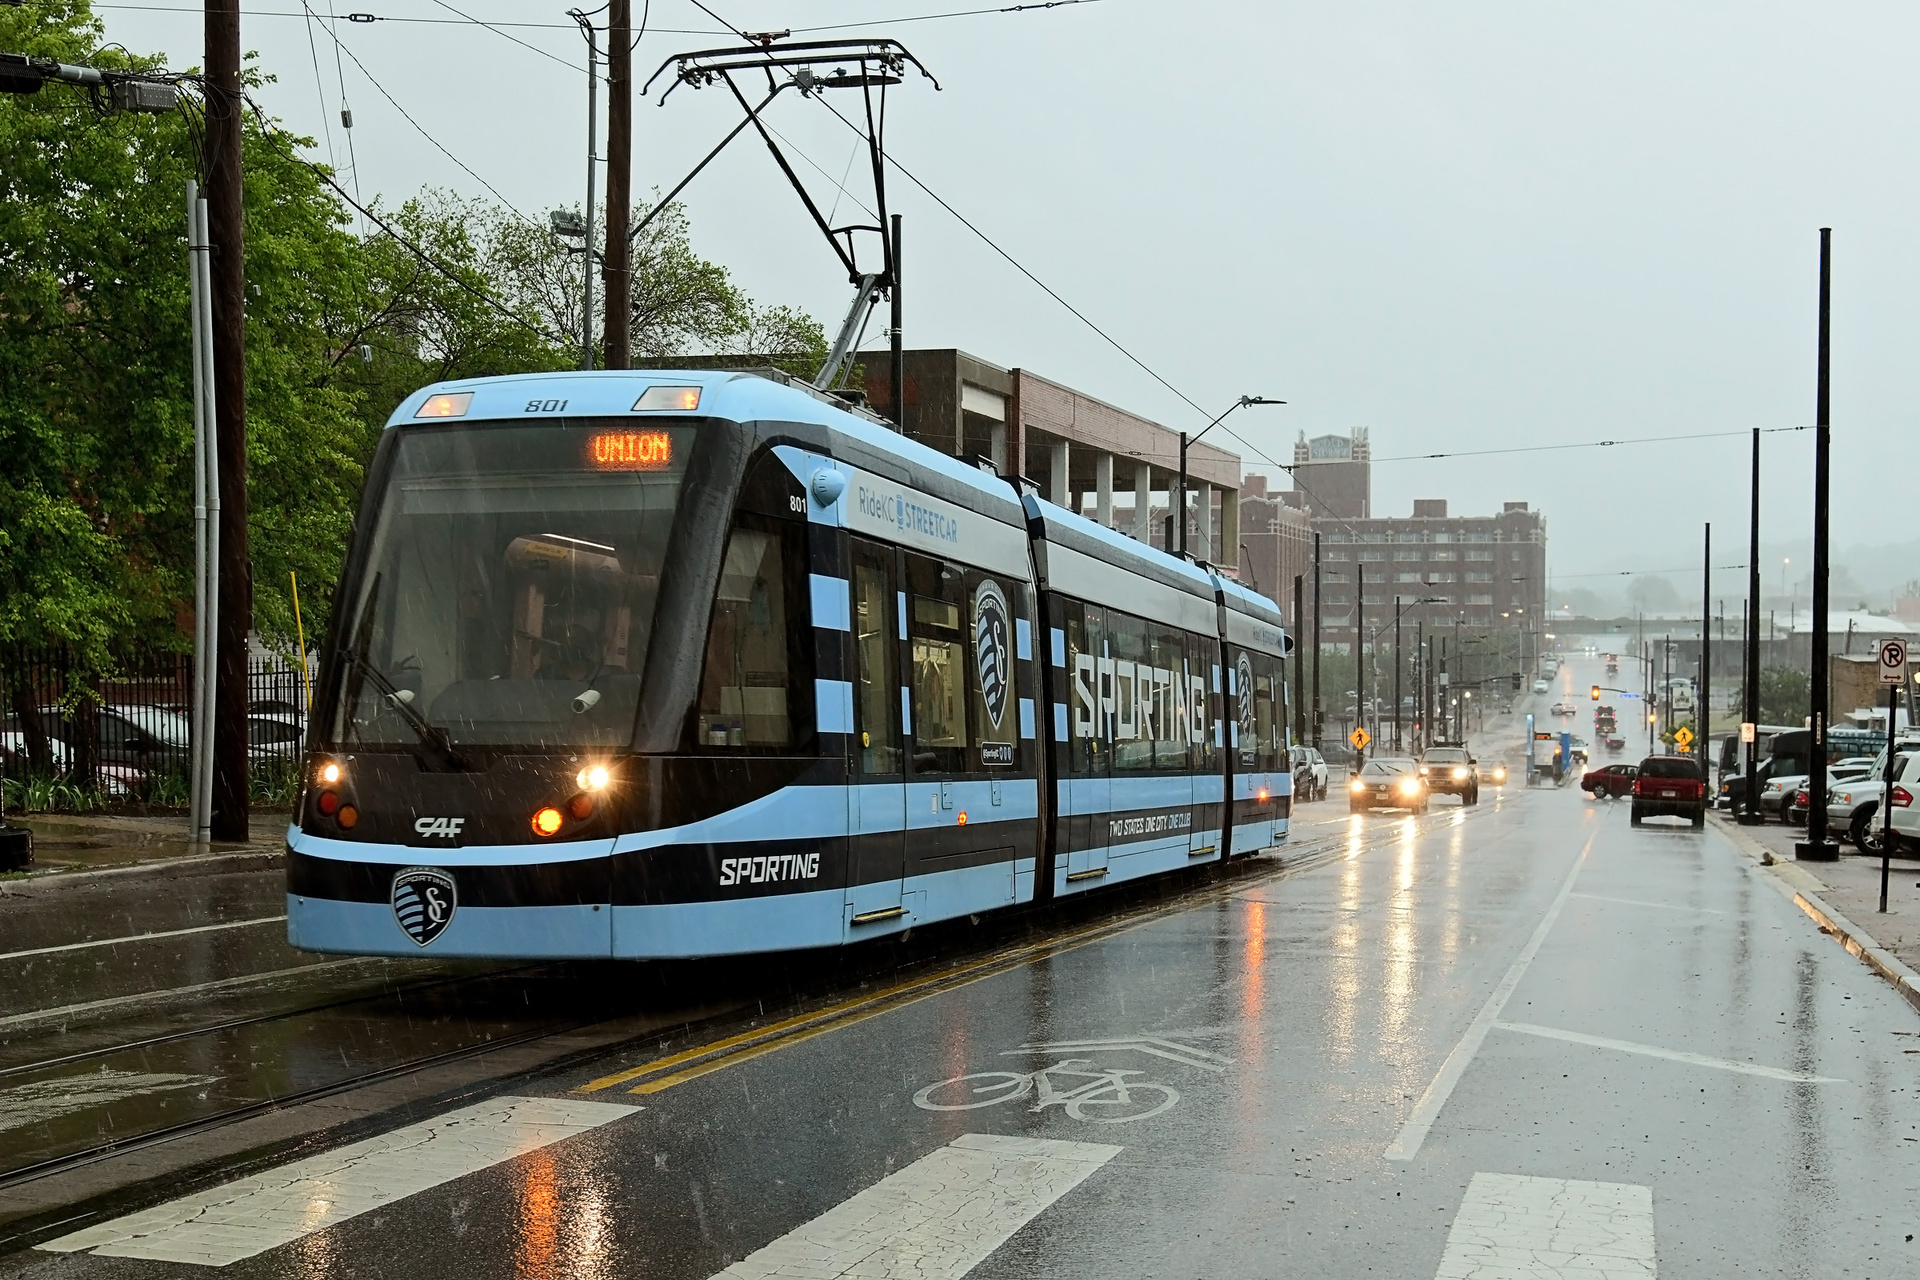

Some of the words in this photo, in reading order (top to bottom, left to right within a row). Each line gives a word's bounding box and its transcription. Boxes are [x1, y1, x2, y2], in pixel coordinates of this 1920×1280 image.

[525, 399, 569, 413] 801
[595, 433, 669, 462] UNION
[790, 495, 807, 514] 801
[859, 486, 895, 523] RideKC
[905, 502, 958, 543] STREETCAR
[1075, 653, 1205, 747] SPORTING
[414, 817, 465, 838] CAF
[1109, 820, 1123, 838] TWO
[1145, 816, 1156, 833] ONE
[1168, 813, 1179, 830] ONE
[720, 853, 820, 885] SPORTING
